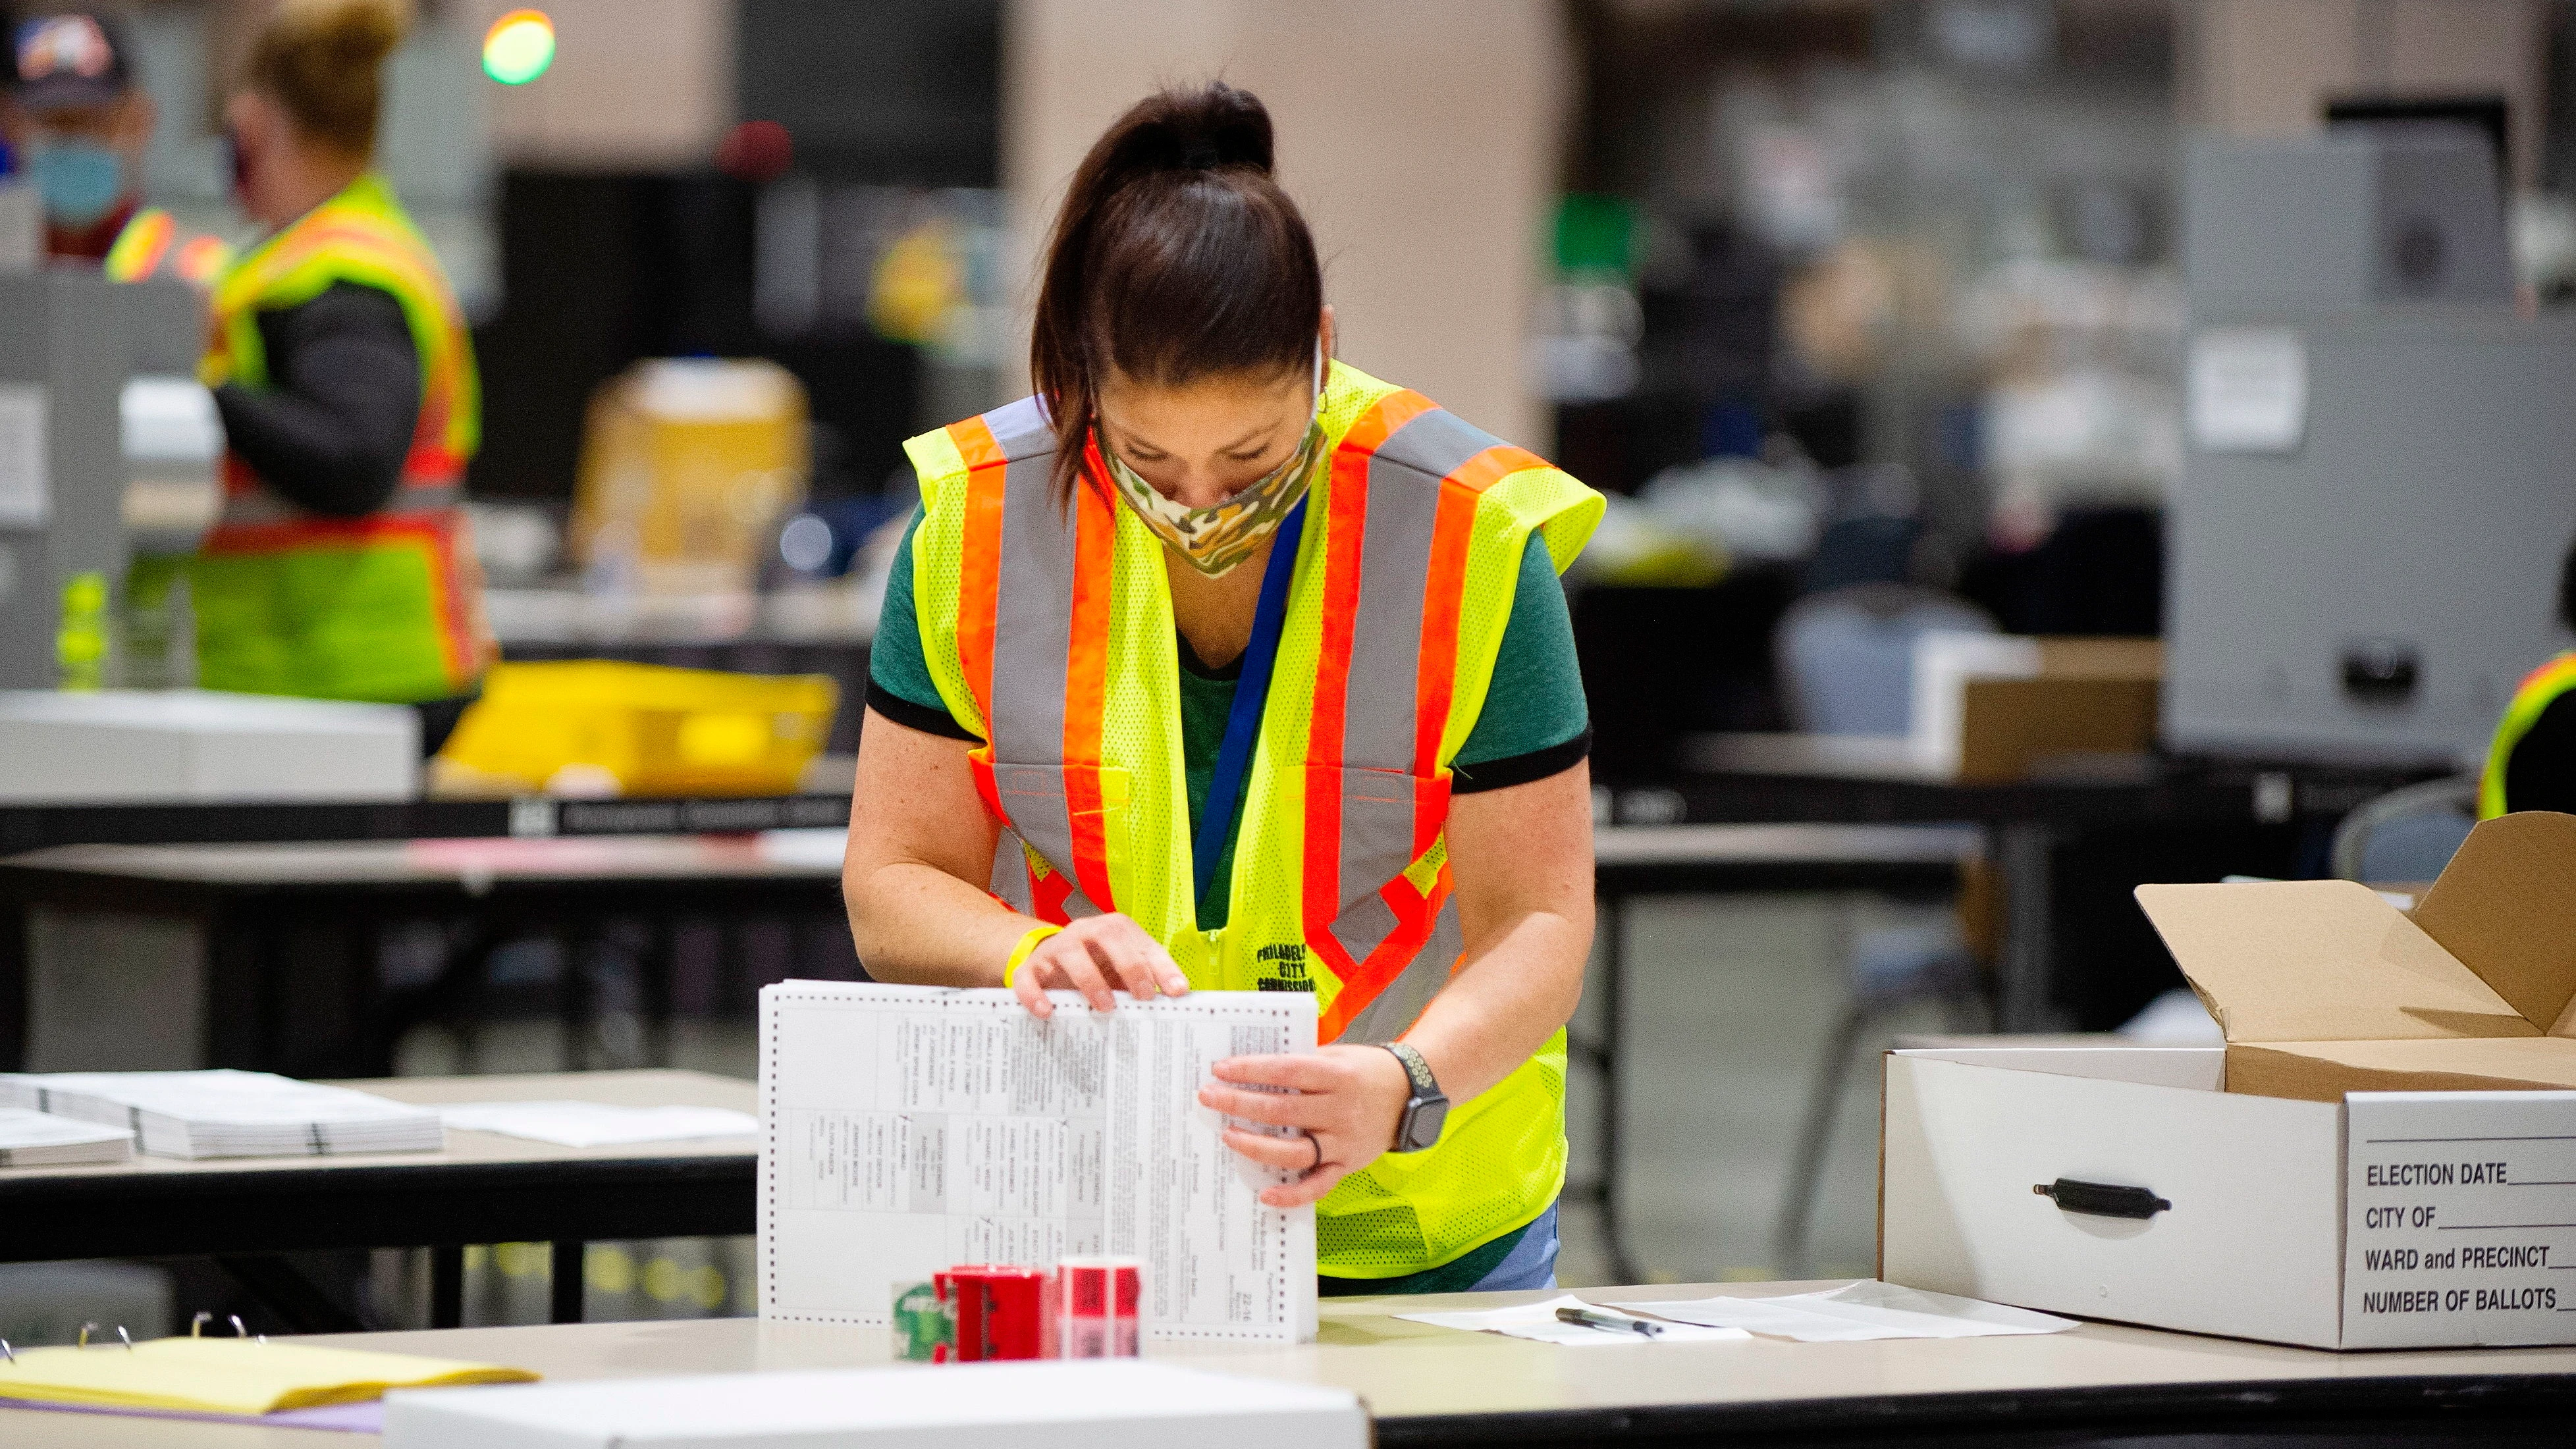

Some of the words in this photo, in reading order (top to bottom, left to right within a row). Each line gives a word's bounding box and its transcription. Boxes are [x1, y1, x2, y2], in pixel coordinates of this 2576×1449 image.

[1279, 961, 1306, 978] CITY
[2367, 1163, 2454, 1186] ELECTION
[2461, 1161, 2508, 1184] DATE
[2366, 1207, 2406, 1229] CITY
[2411, 1206, 2436, 1228] OF
[2365, 1248, 2419, 1271] WARD
[2425, 1248, 2455, 1269] and
[2462, 1246, 2550, 1269] PRECINCT
[2363, 1291, 2439, 1313] NUMBER
[2445, 1290, 2469, 1311] OF
[2476, 1288, 2557, 1310] BALLOTS
